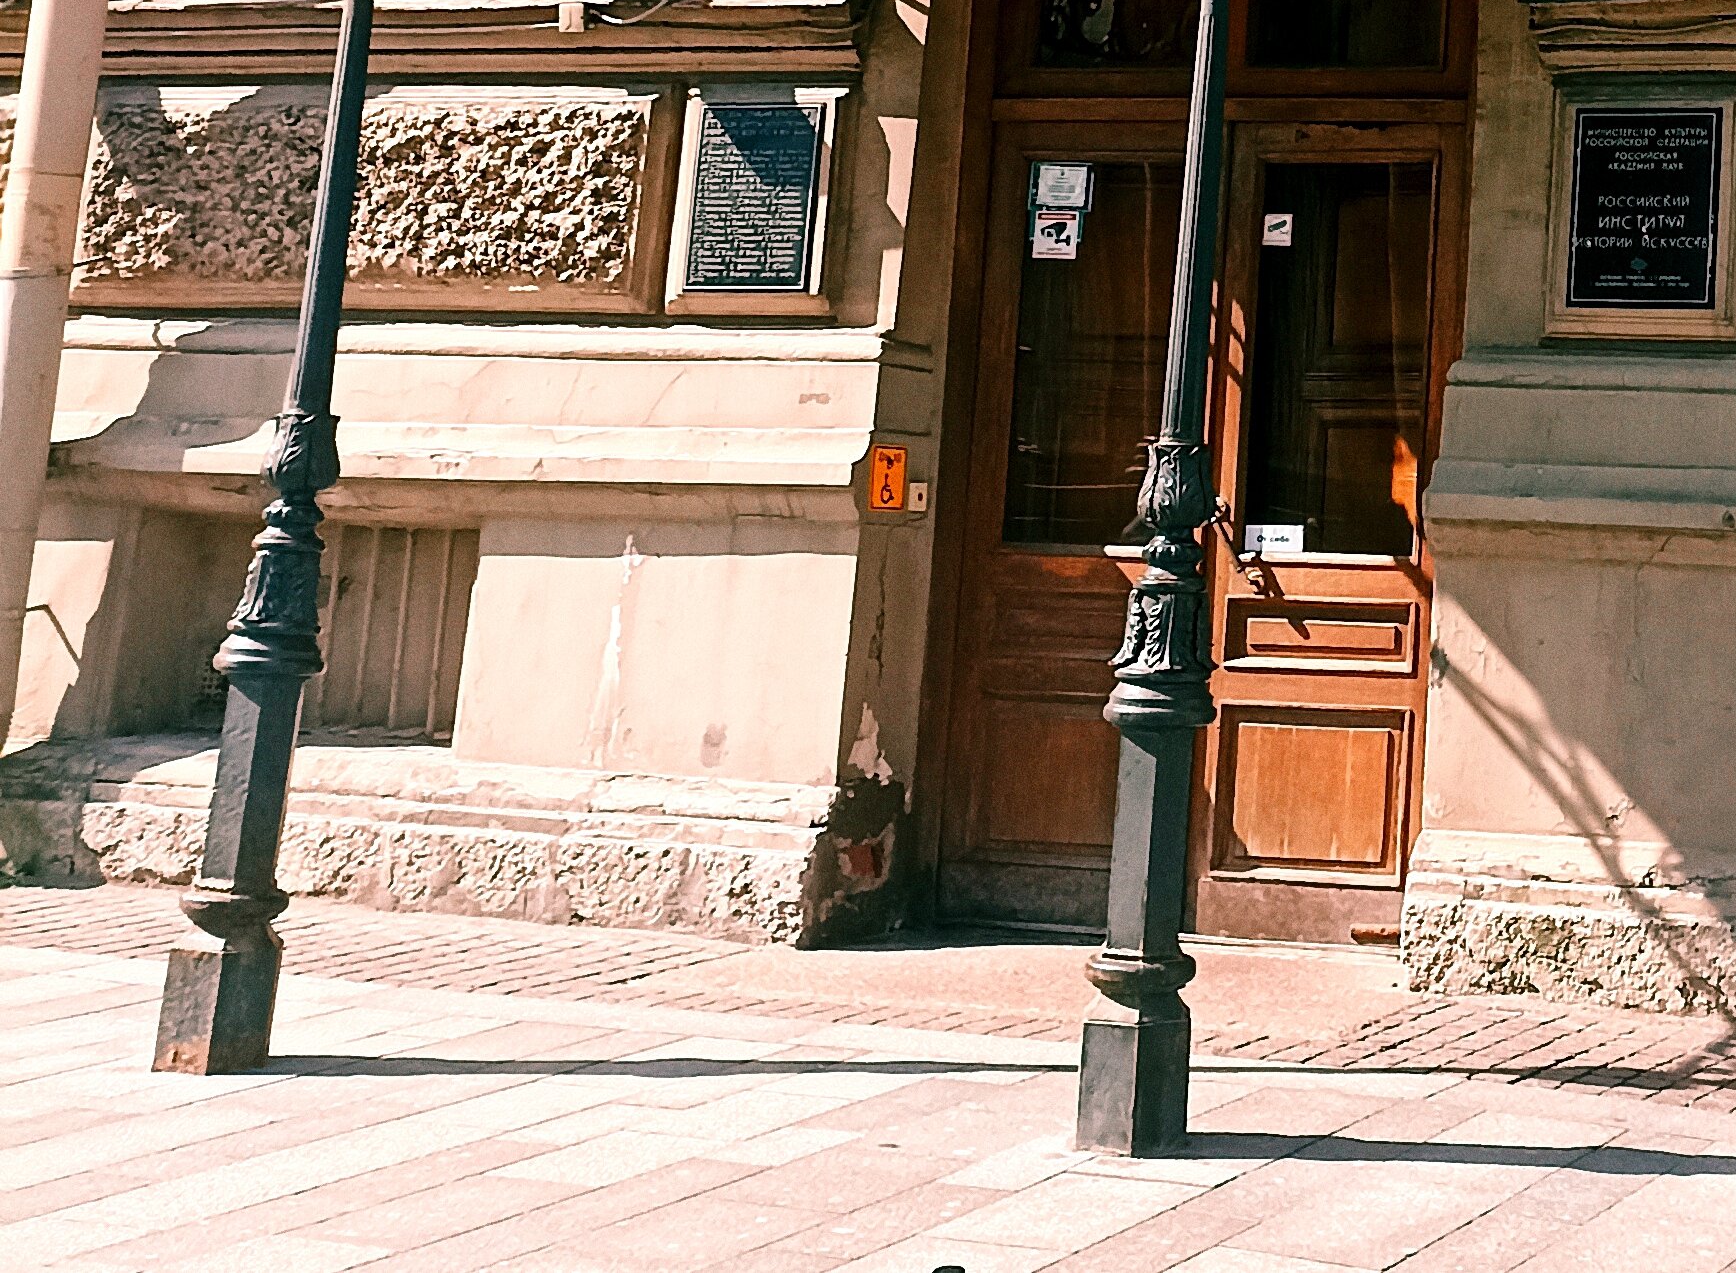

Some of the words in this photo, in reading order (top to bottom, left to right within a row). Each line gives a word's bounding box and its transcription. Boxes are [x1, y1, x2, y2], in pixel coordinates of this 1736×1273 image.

[1598, 194, 1690, 207] РОССИЙСКИЙ
[1598, 214, 1686, 230] ИНСТИТУТ
[1574, 236, 1633, 249] ИСТОРИИ
[1641, 236, 1708, 249] ИСКУССТВ
